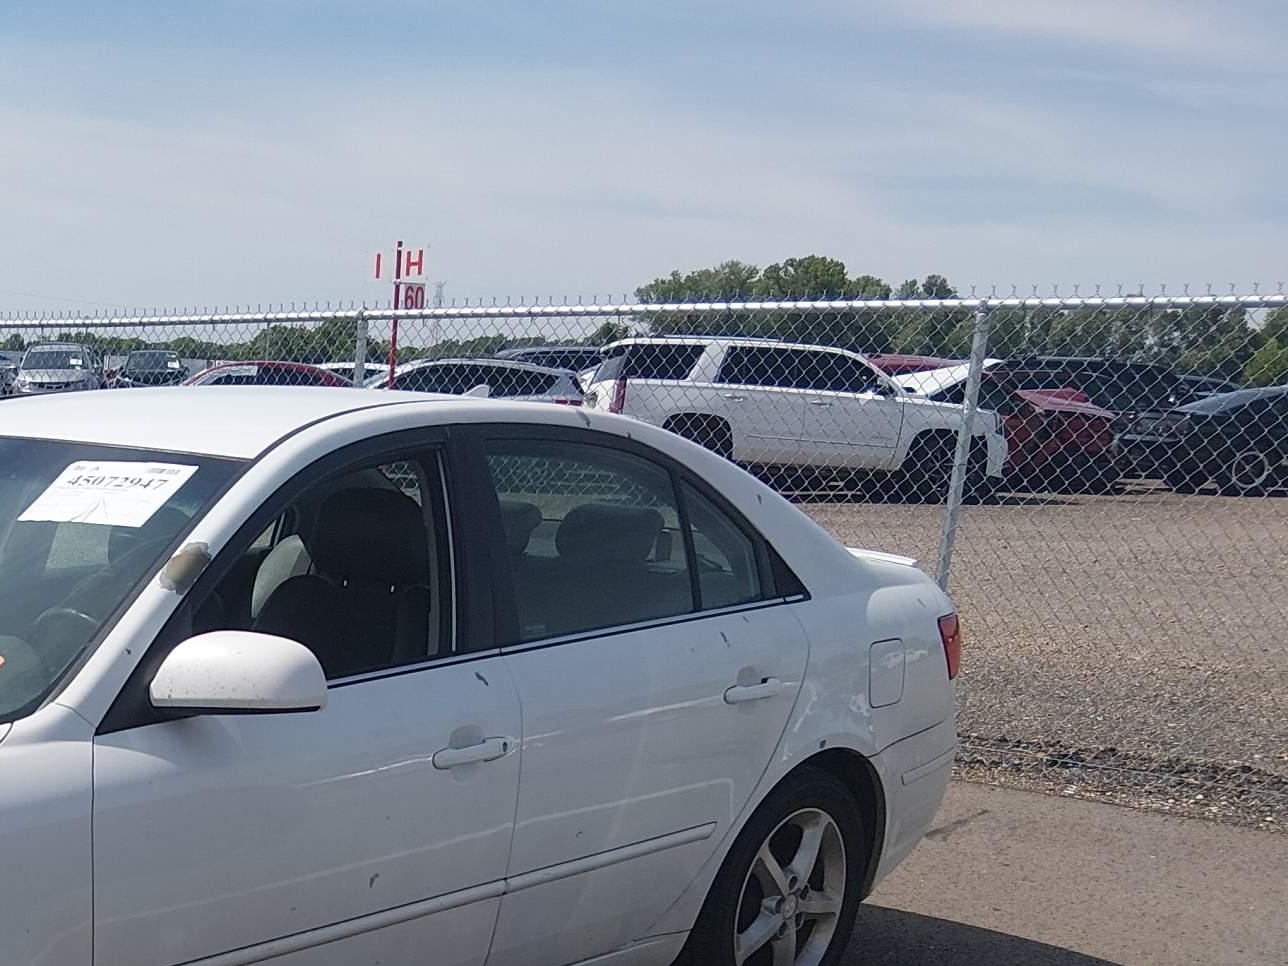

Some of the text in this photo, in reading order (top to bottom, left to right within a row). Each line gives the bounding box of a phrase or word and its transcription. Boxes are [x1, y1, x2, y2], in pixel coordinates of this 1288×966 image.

[406, 249, 423, 276] H
[404, 285, 424, 310] 60
[67, 475, 169, 490] 45072947
